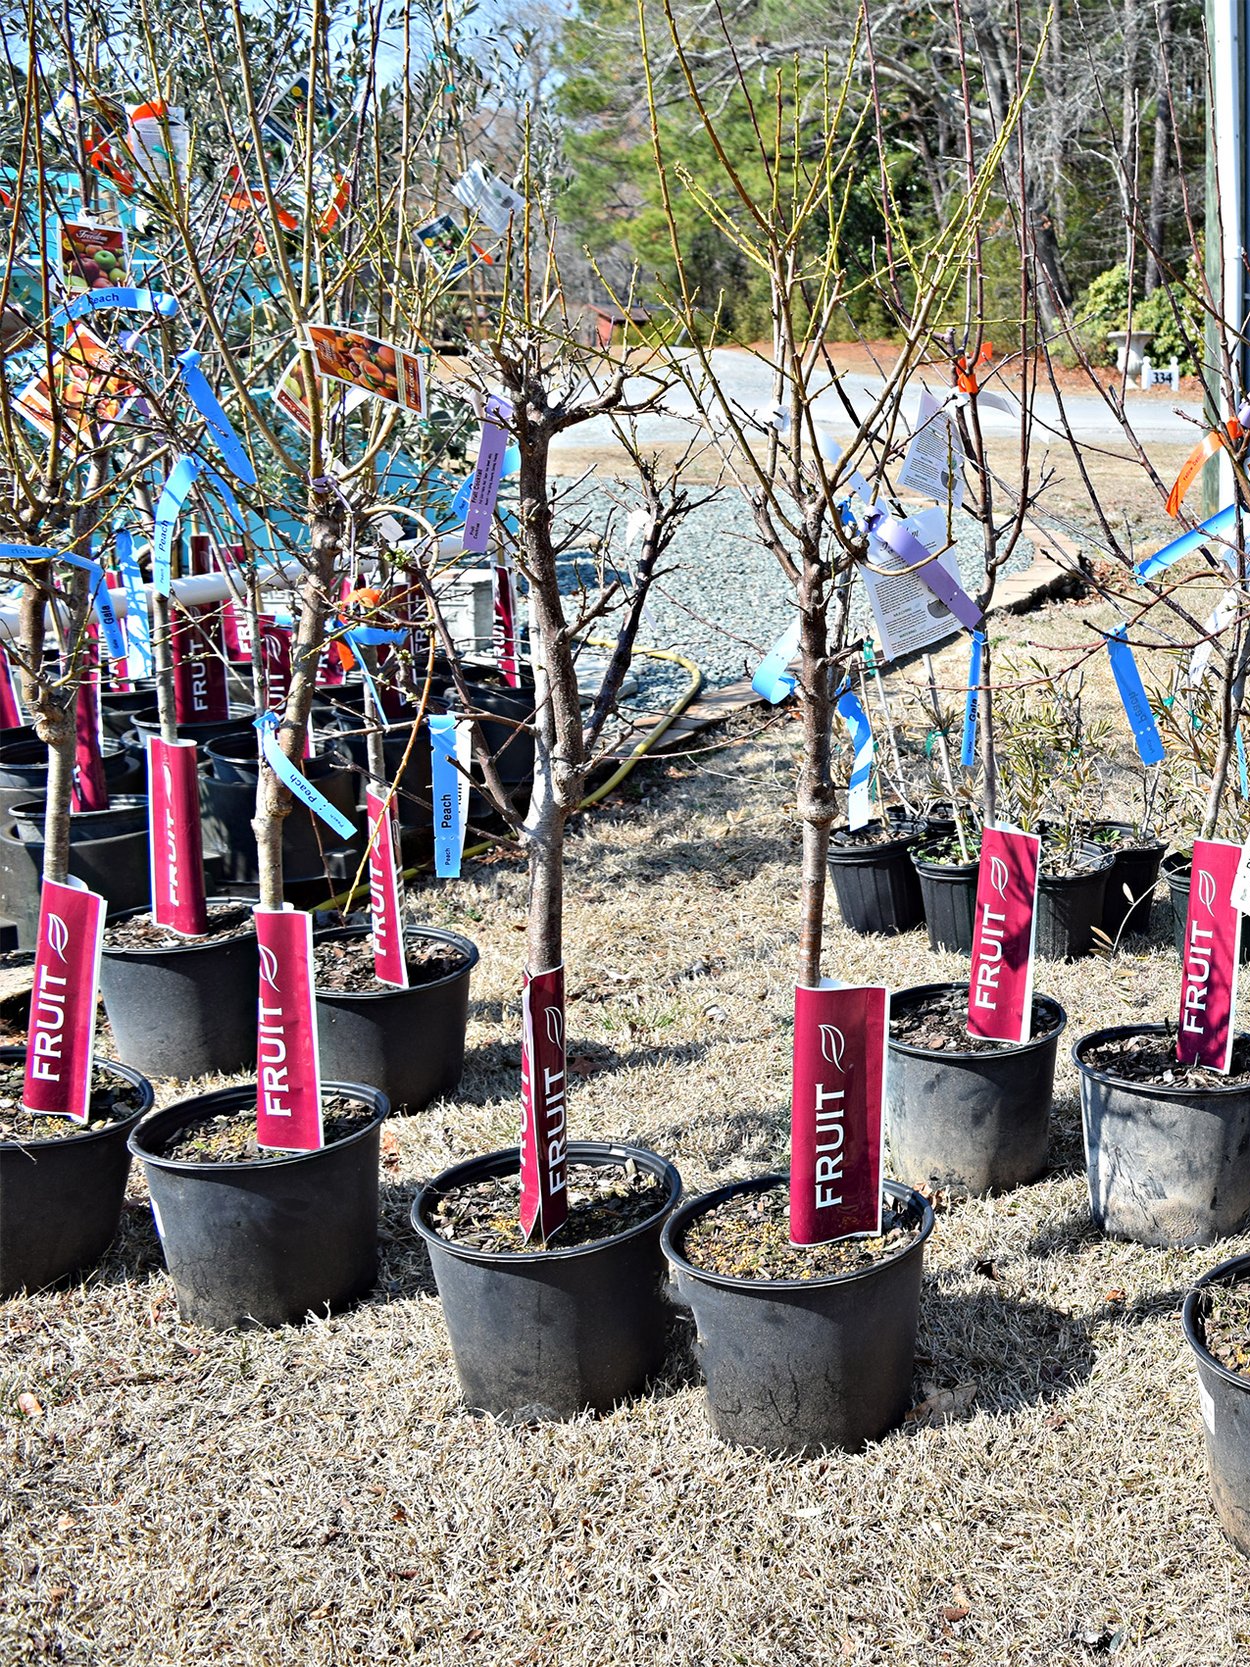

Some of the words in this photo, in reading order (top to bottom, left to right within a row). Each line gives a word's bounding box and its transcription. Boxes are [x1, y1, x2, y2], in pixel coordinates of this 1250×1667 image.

[1152, 372, 1173, 384] 334
[158, 518, 169, 553] Peach
[103, 604, 111, 625] Gala
[969, 698, 978, 722] Gala
[289, 773, 318, 804] Peach
[441, 794, 452, 829] Peach
[166, 808, 179, 907] FRUIT
[370, 858, 387, 957] FRUIT
[974, 903, 1006, 1011] FRUIT
[33, 966, 69, 1082] FRUIT
[1182, 920, 1215, 1035] FRUIT
[259, 994, 291, 1117] FRUIT
[544, 1067, 566, 1197] FRUIT
[814, 1083, 846, 1211] FRUIT
